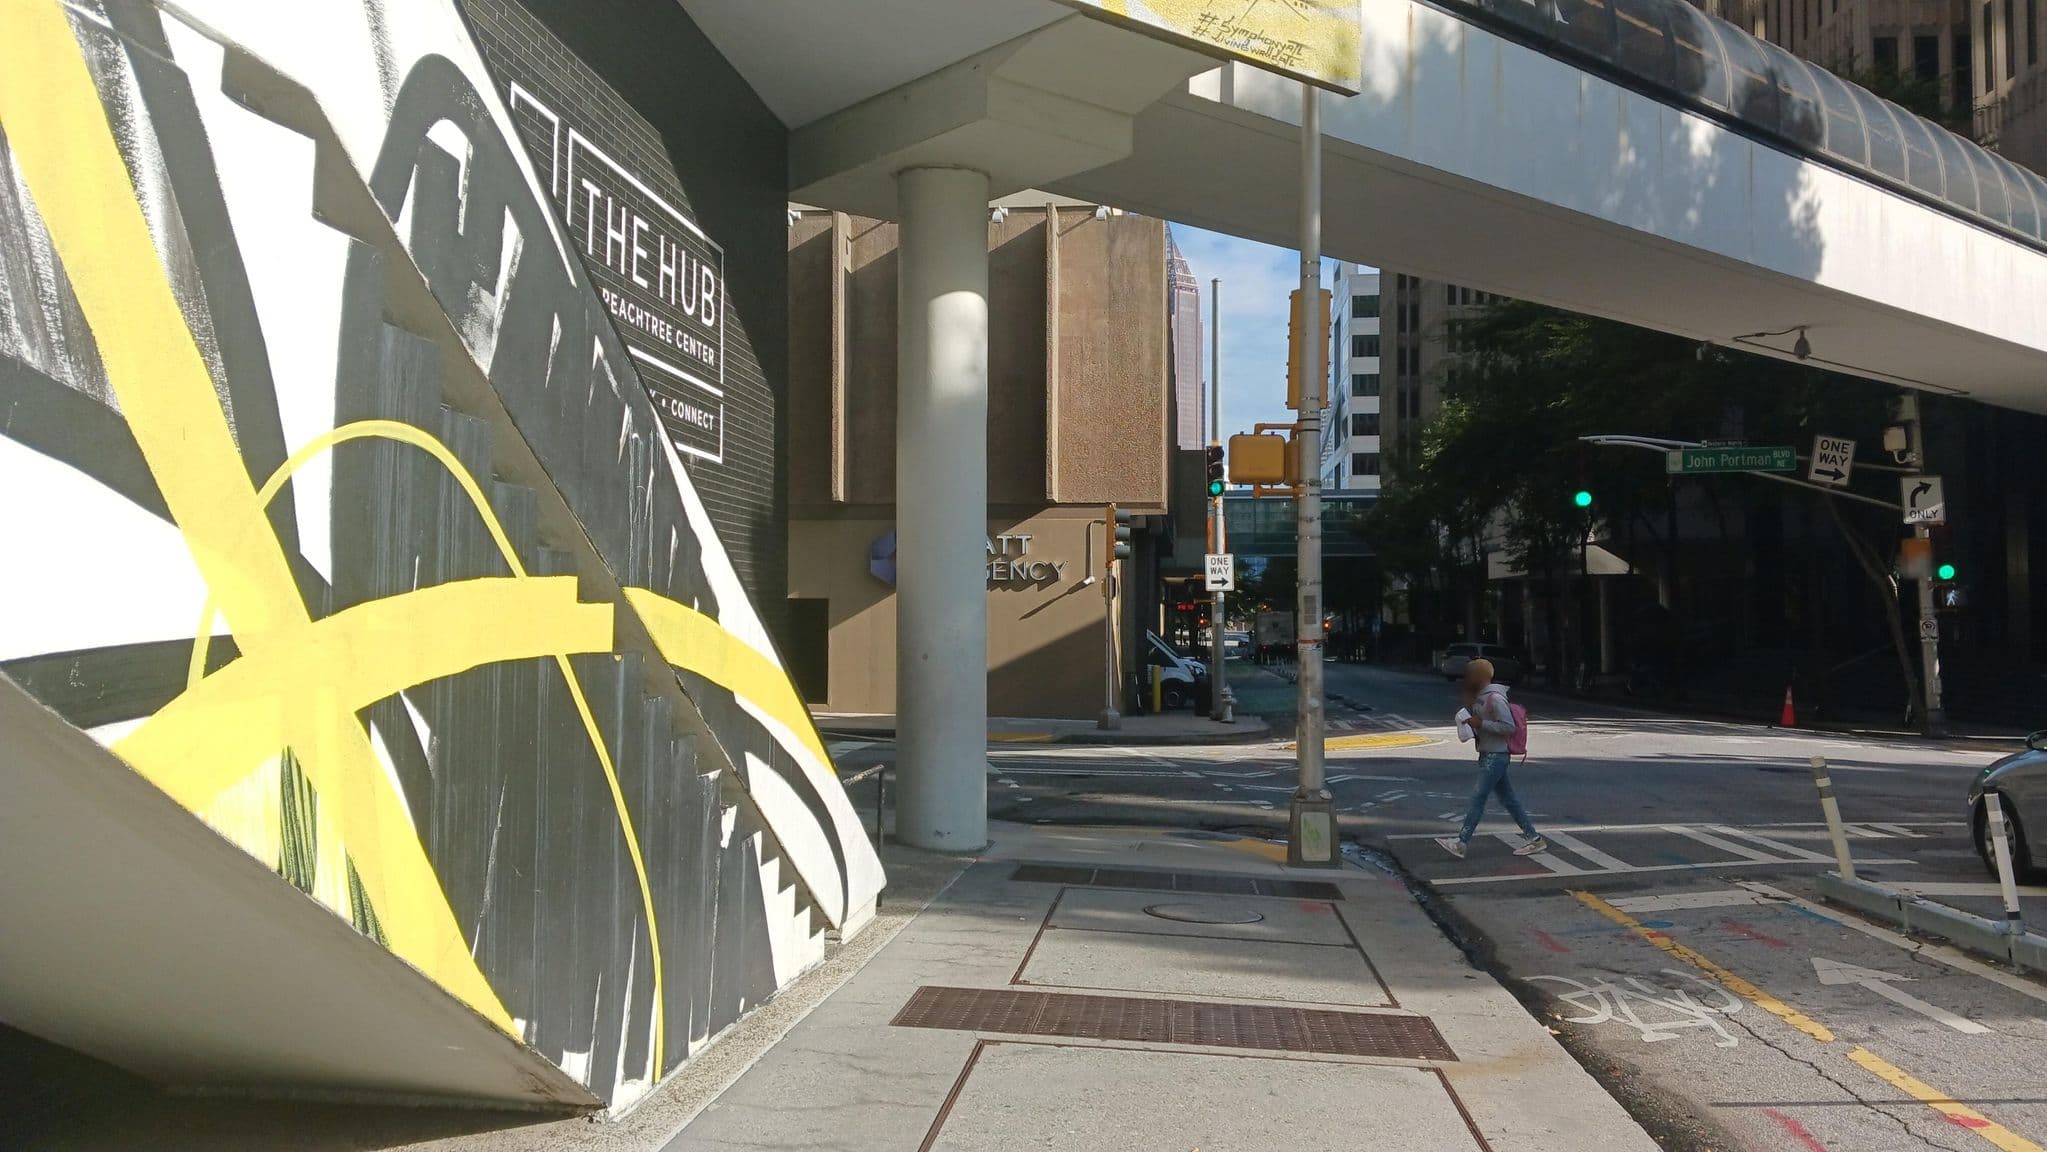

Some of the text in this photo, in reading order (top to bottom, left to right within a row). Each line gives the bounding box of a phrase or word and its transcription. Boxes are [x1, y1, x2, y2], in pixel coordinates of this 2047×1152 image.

[581, 177, 716, 327] THE HUB
[602, 288, 715, 367] PEACHTREE CENTER
[671, 399, 714, 431] CONNECT
[1819, 439, 1850, 454] ONE
[1686, 450, 1791, 468] John Portman BLVD
[1818, 452, 1849, 466] WAY
[1909, 509, 1939, 520] ONLY
[1210, 557, 1229, 566] ONE
[1210, 567, 1229, 575] WAY
